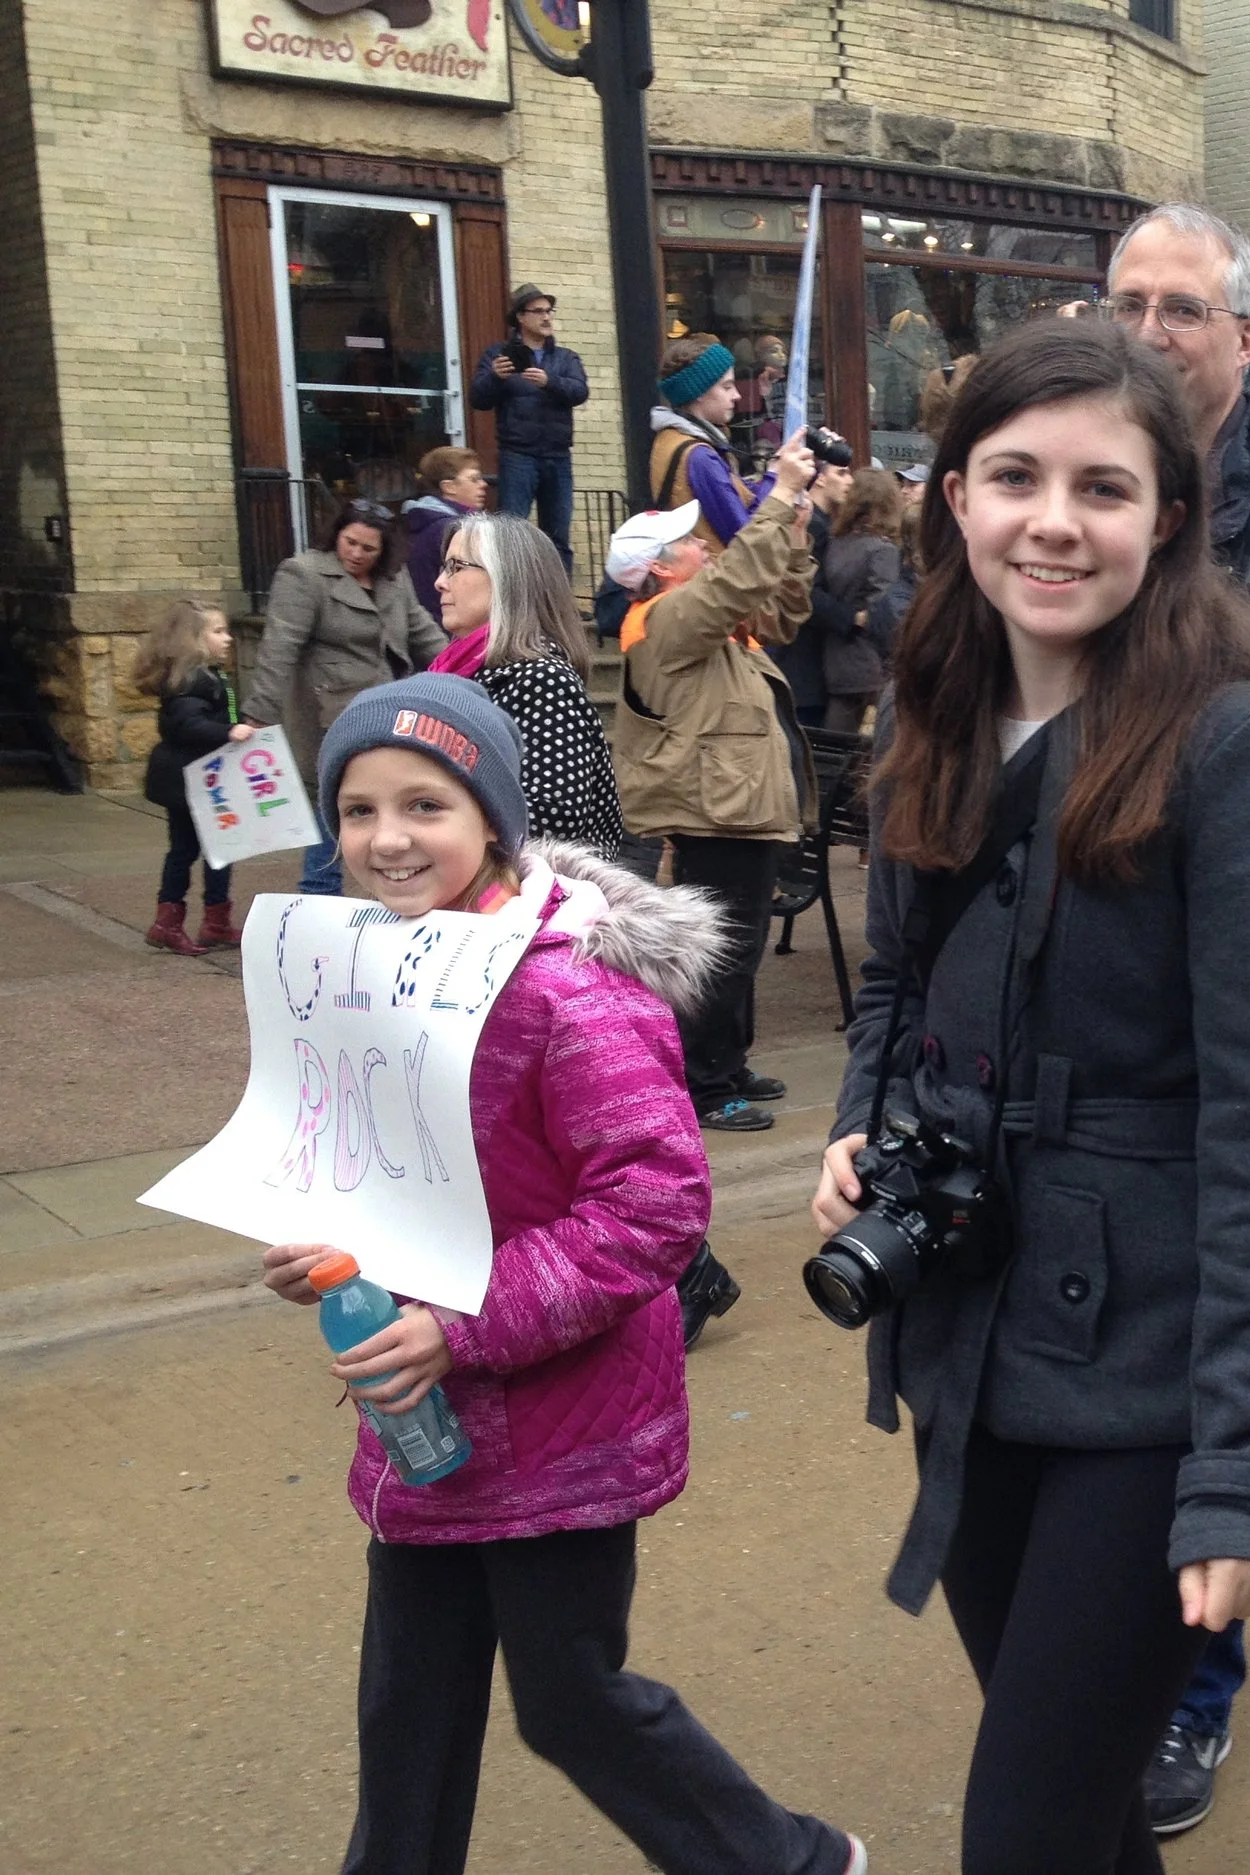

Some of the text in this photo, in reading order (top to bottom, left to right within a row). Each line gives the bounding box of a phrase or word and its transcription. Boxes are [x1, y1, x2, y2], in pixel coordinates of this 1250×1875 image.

[243, 15, 486, 80] Sacred Feather
[262, 1030, 450, 1194] ROCK
